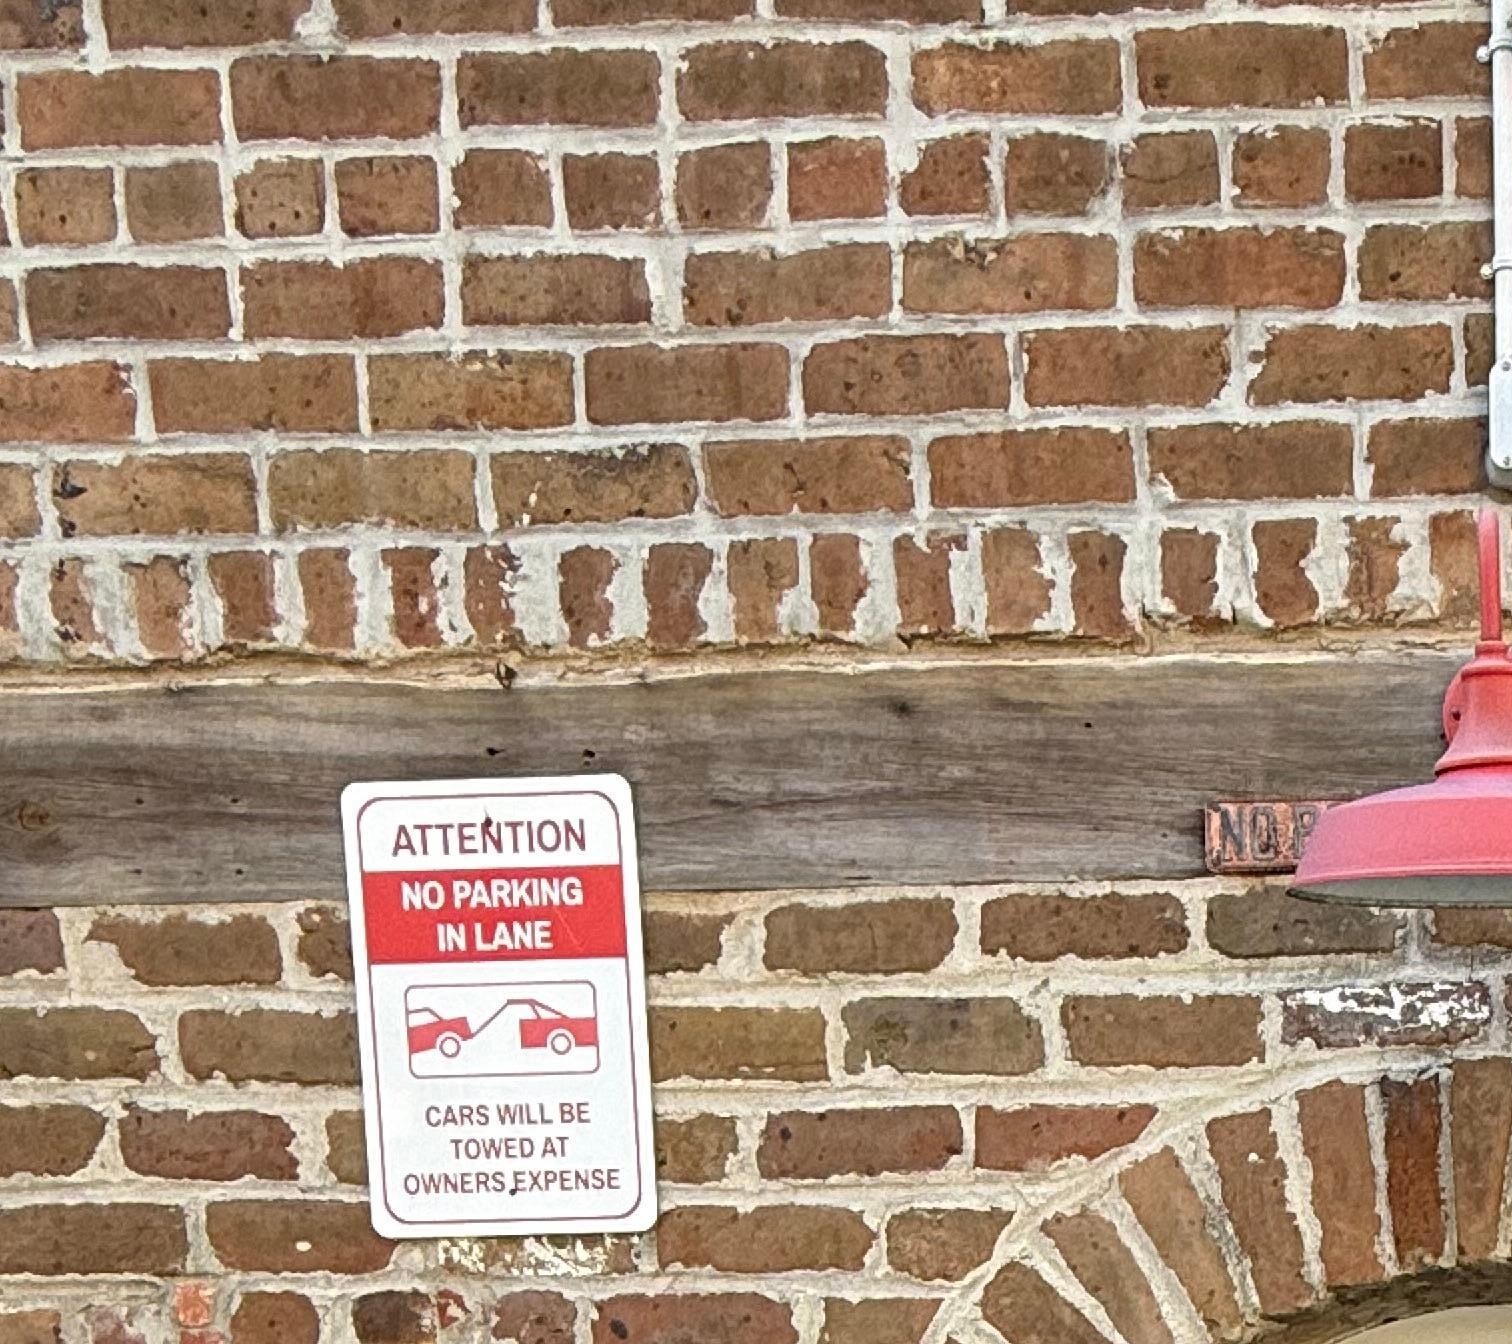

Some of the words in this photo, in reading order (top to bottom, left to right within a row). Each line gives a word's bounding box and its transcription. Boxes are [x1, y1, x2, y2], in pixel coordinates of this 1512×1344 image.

[392, 819, 586, 857] ATTENTION
[1219, 804, 1277, 862] NO
[401, 880, 445, 911] NO
[453, 876, 583, 908] PARKING
[437, 923, 467, 951] IN
[474, 921, 553, 950] LANE
[425, 1105, 489, 1127] CARS
[496, 1104, 553, 1126] WILL
[559, 1103, 590, 1124] BE
[451, 1138, 535, 1160] TOWED
[541, 1136, 569, 1158] AT
[403, 1172, 505, 1195] OWNERS
[514, 1169, 620, 1192] EXPENSE
